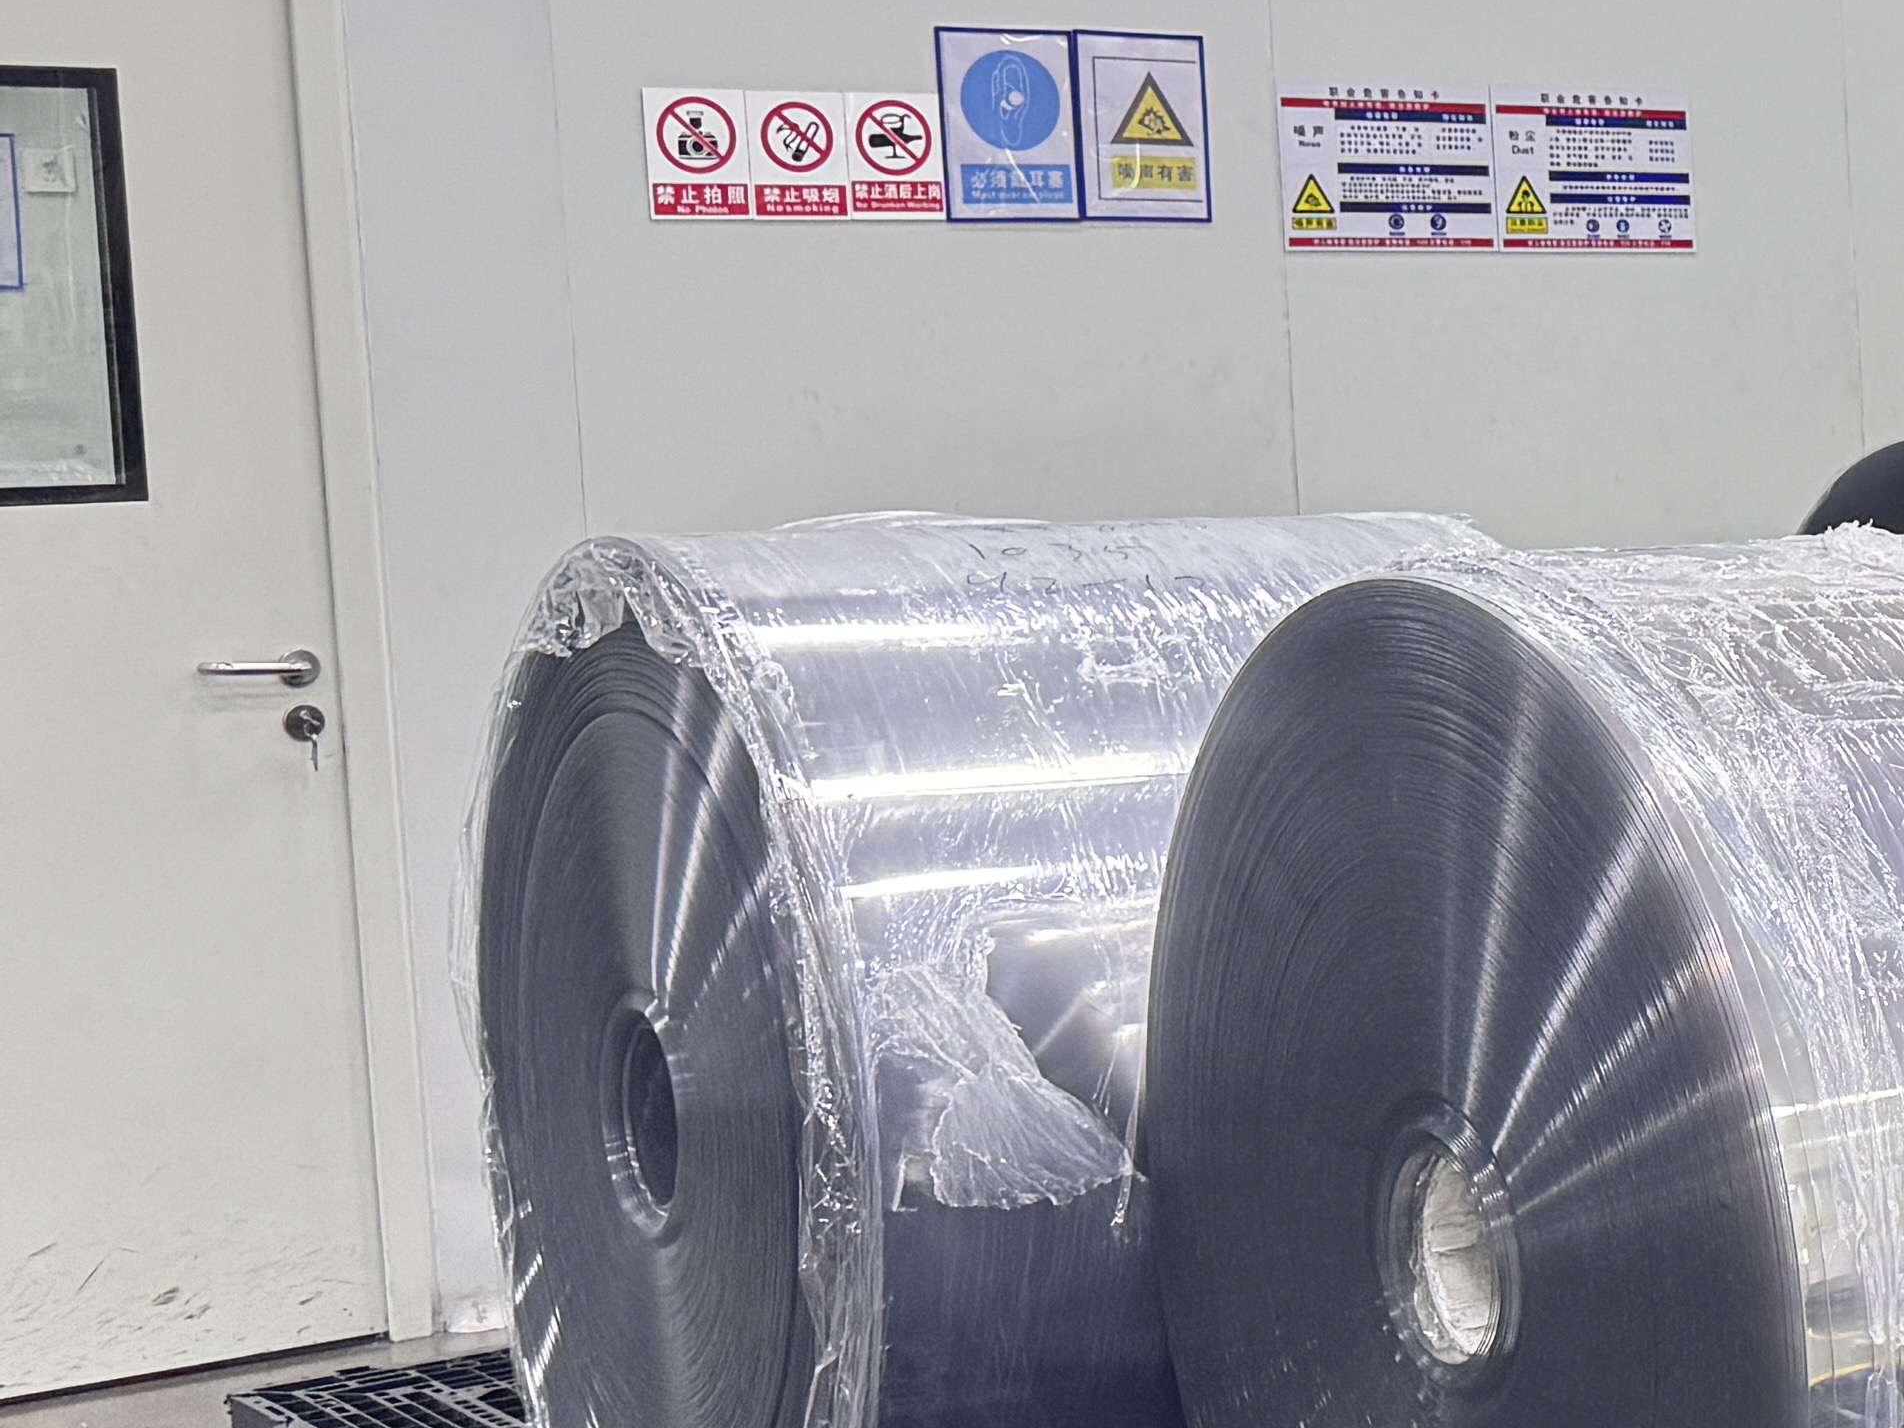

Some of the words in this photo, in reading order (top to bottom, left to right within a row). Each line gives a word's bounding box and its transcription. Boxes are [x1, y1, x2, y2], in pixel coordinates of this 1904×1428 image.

[1511, 145, 1534, 155] Dust
[656, 185, 745, 205] 禁止拍照
[763, 186, 840, 204] 禁止吸烟
[855, 183, 941, 200] 禁止酒后上岗
